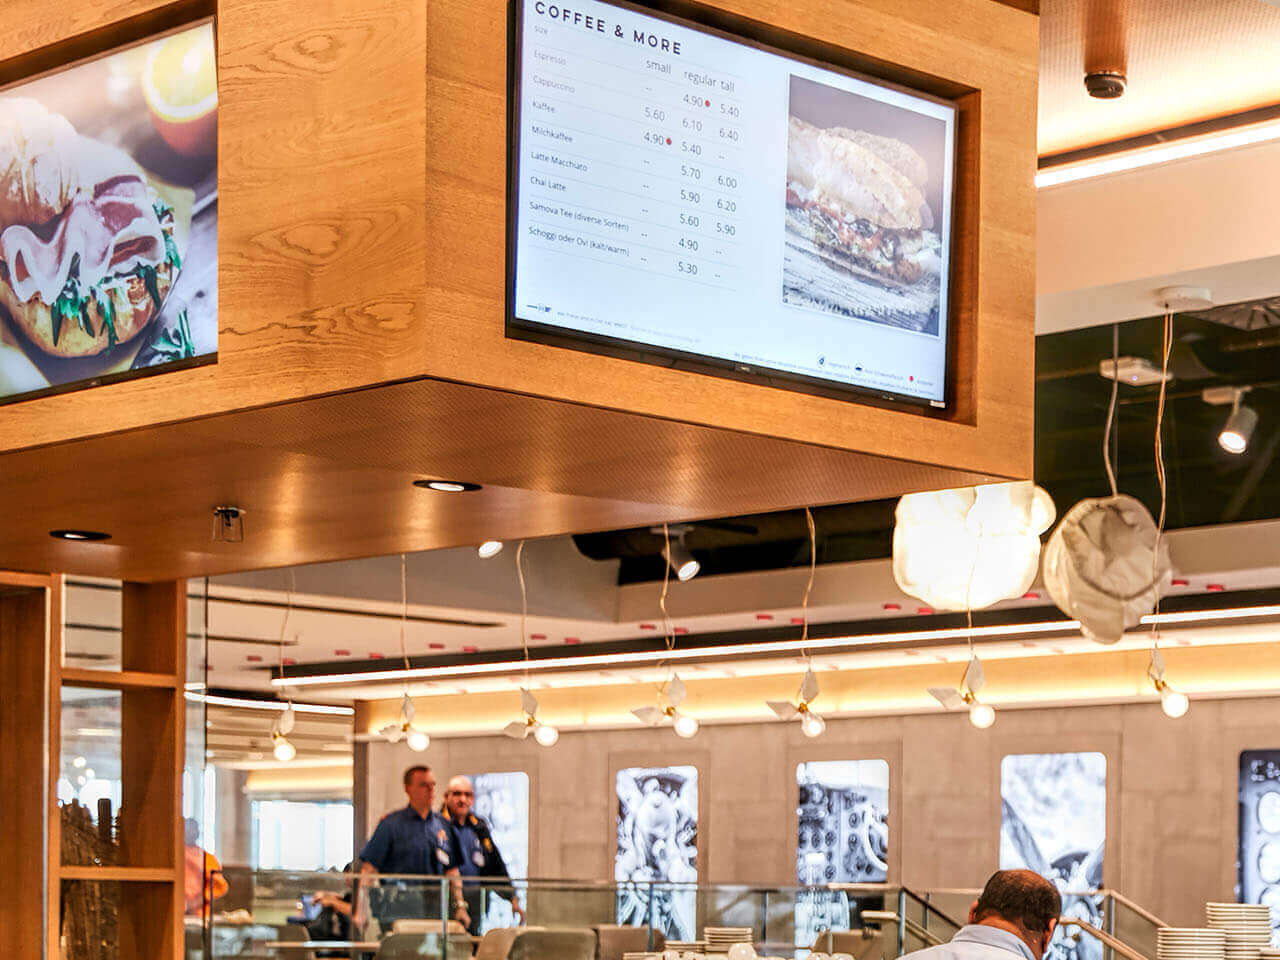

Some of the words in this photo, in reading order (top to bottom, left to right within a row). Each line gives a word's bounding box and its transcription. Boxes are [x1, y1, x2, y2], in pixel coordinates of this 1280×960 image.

[535, 1, 605, 33] COFFEE
[614, 24, 624, 39] &
[633, 29, 682, 55] MORE
[646, 60, 671, 74] small
[684, 71, 716, 87] regular
[720, 80, 735, 93] tall
[532, 101, 555, 113] Kaffee
[644, 131, 664, 146] 4.90
[681, 141, 702, 156] 5.40
[644, 107, 665, 122] 5.60
[682, 118, 702, 132] 6.10
[719, 128, 739, 142] 6.40
[683, 94, 703, 108] 4.90
[720, 103, 740, 118] 5.40
[530, 152, 549, 163] Latte
[551, 156, 588, 172] Macchiato
[680, 189, 700, 204] 5.90
[717, 199, 737, 213] 6.20
[531, 125, 573, 143] Milchkaffee
[681, 165, 701, 180] 5.70
[718, 175, 737, 189] 6.00
[529, 201, 559, 216] Samova
[560, 208, 573, 218] Tee
[574, 211, 602, 226] (diverse
[603, 219, 630, 233] Sorten)
[678, 238, 699, 252] 4.90
[530, 176, 546, 187] Chai
[548, 179, 567, 192] Latte
[679, 213, 700, 228] 5.60
[716, 222, 736, 236] 5.90
[528, 226, 557, 242] Schoggi
[558, 233, 575, 244] oder
[678, 261, 698, 276] 5.30
